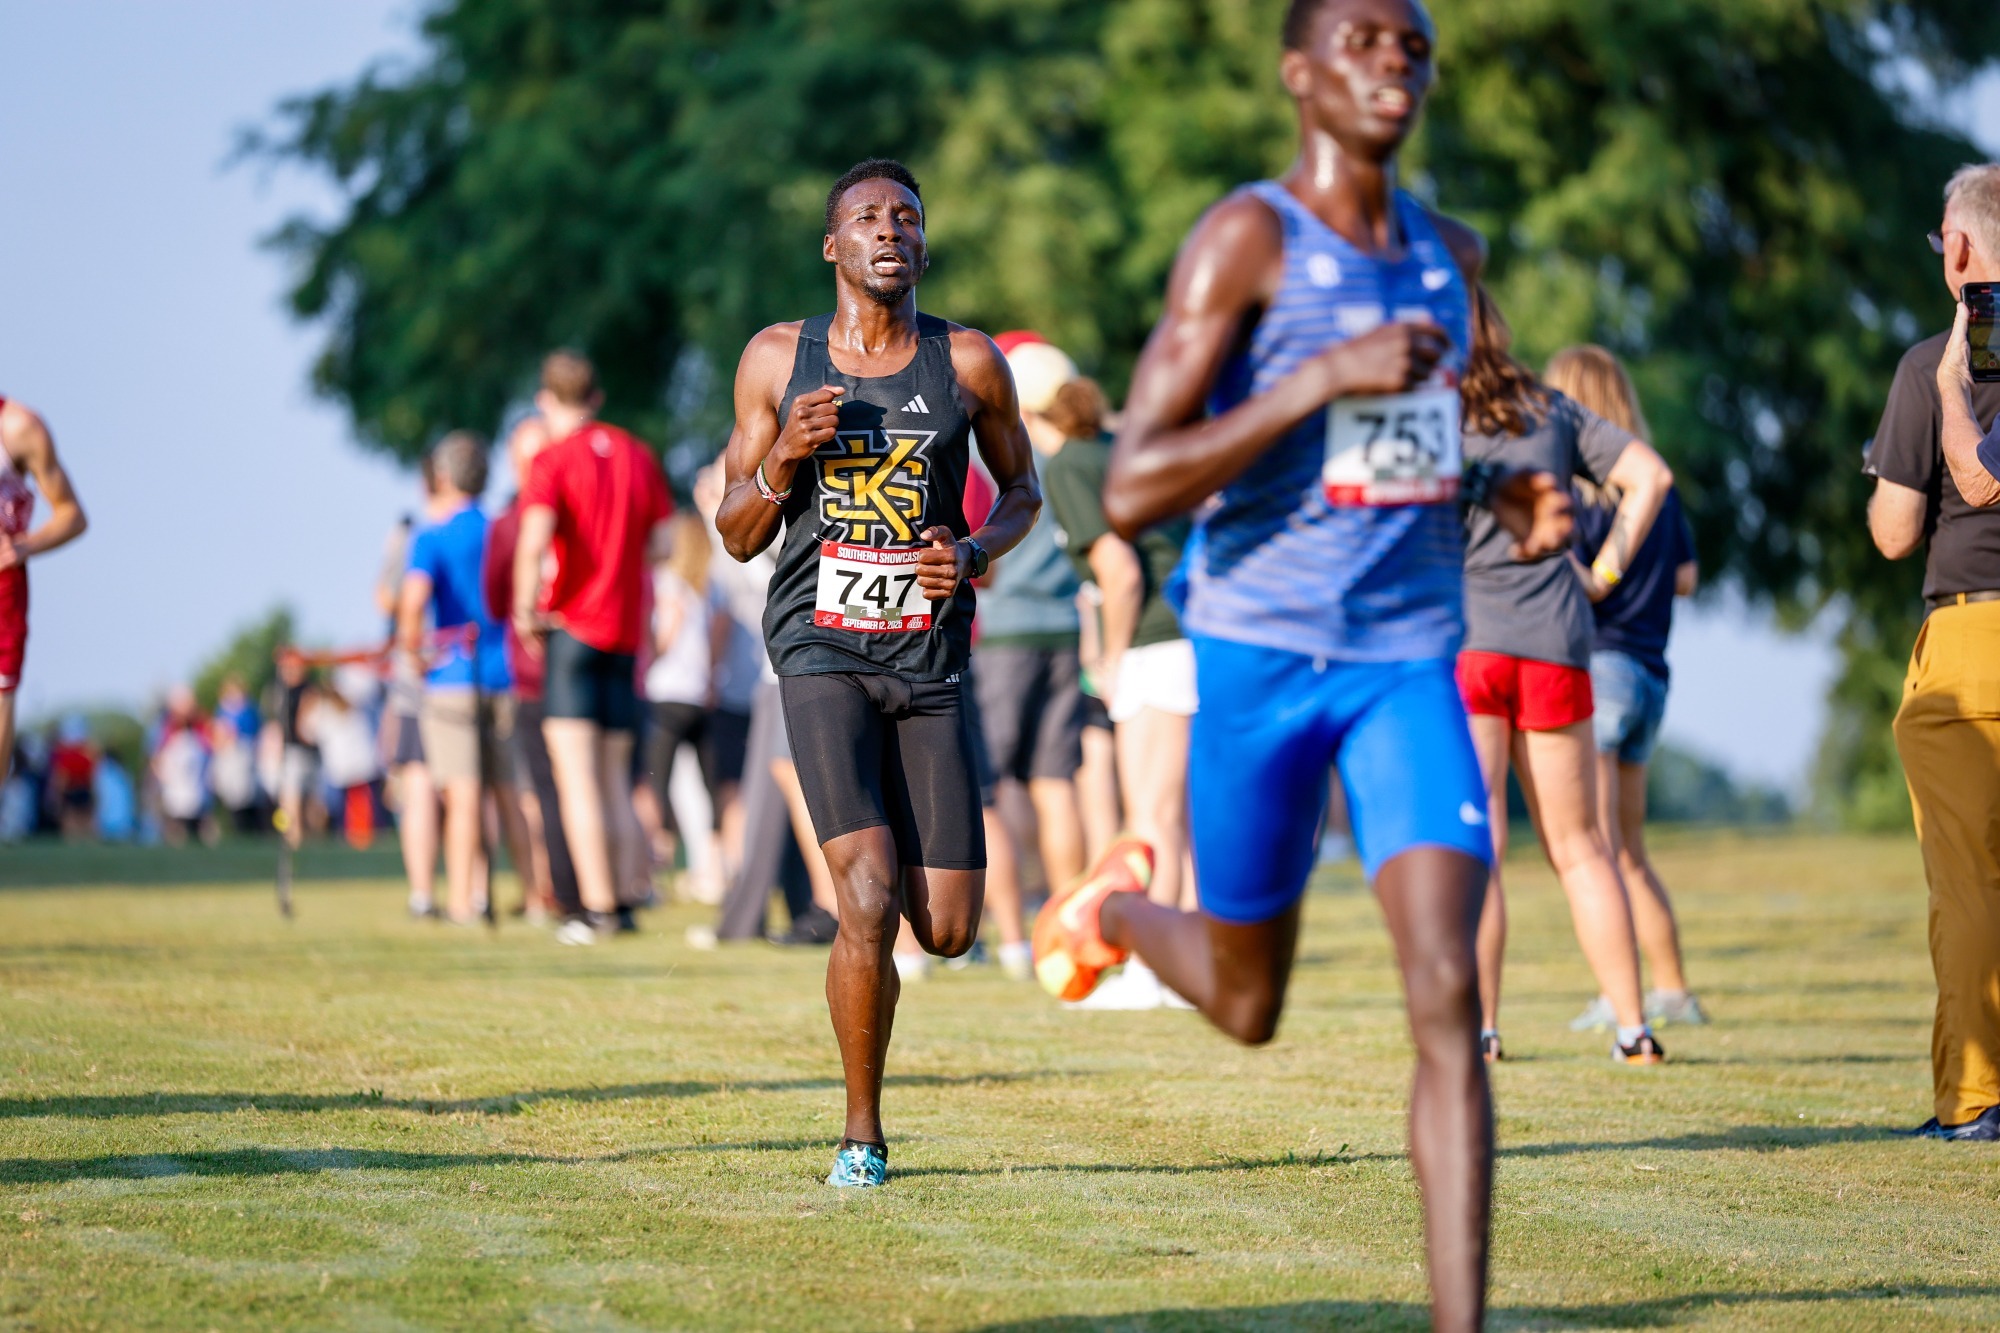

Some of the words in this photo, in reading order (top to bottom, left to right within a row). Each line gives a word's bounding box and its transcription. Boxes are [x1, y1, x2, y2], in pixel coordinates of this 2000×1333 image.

[837, 547, 878, 562] SOUTHERN
[836, 569, 917, 609] 747
[842, 618, 878, 630] SEPTEMBER
[887, 619, 902, 630] 2025
